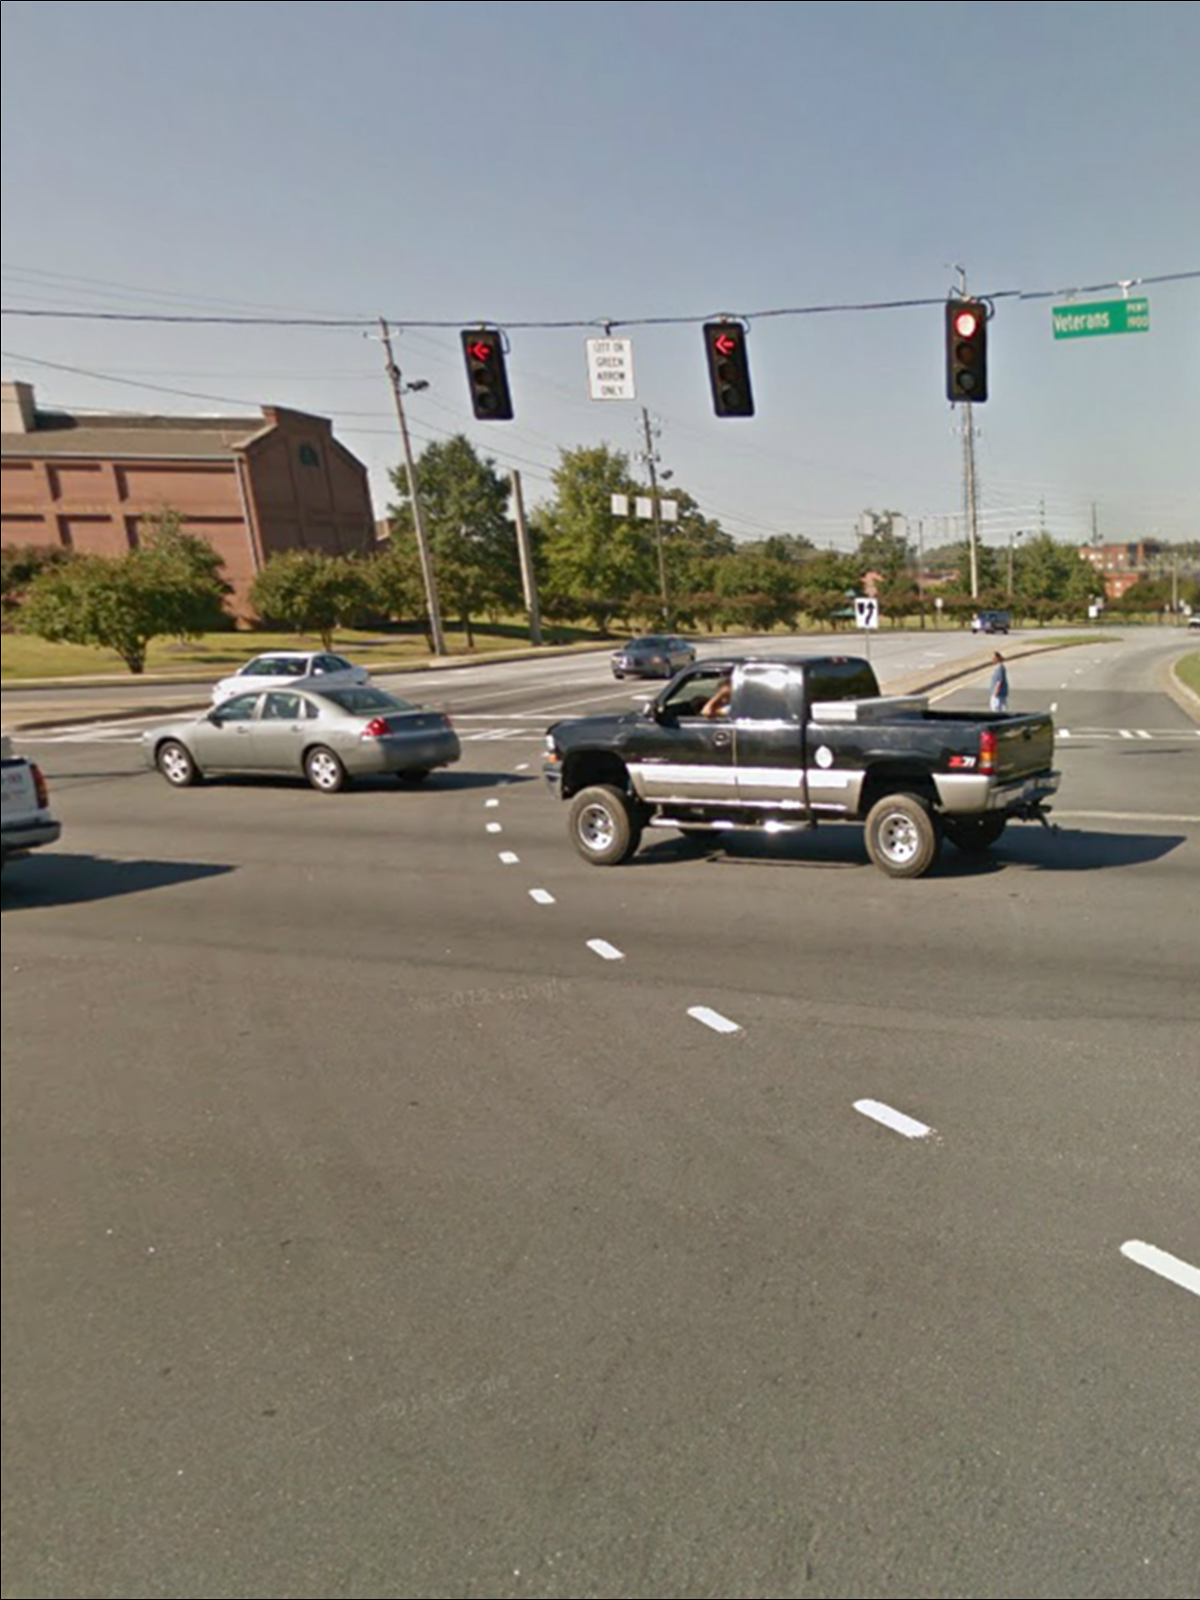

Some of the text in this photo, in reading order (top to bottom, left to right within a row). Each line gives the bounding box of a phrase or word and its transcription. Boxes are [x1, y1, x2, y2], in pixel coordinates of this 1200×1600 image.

[1053, 312, 1109, 332] Veterans
[596, 356, 624, 367] GREEN
[597, 371, 625, 381] ARROW
[601, 385, 623, 396] ONLY
